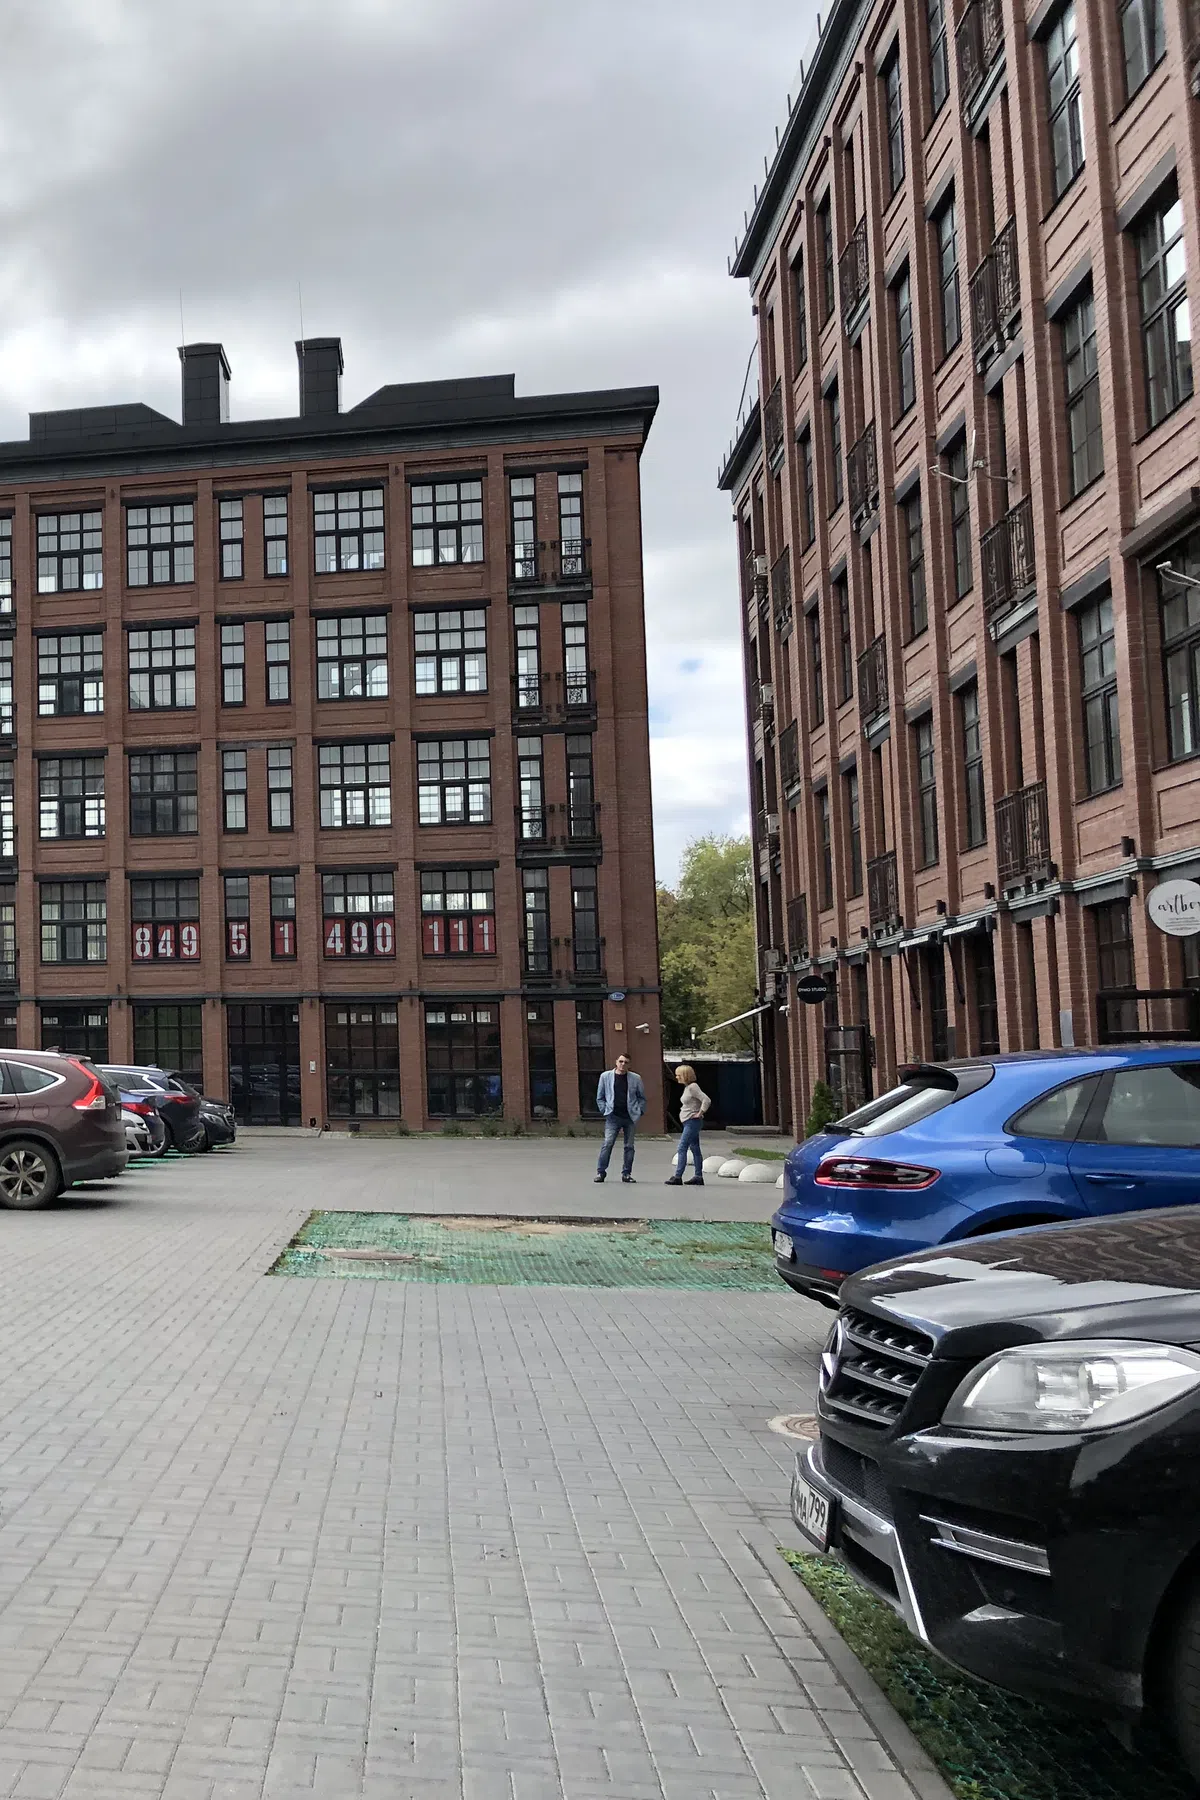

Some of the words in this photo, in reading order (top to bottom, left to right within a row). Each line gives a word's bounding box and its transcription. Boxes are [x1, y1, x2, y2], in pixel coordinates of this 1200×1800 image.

[135, 925, 198, 957] 849
[326, 921, 393, 954] 490
[428, 919, 490, 952] 111
[809, 1491, 826, 1528] 799
